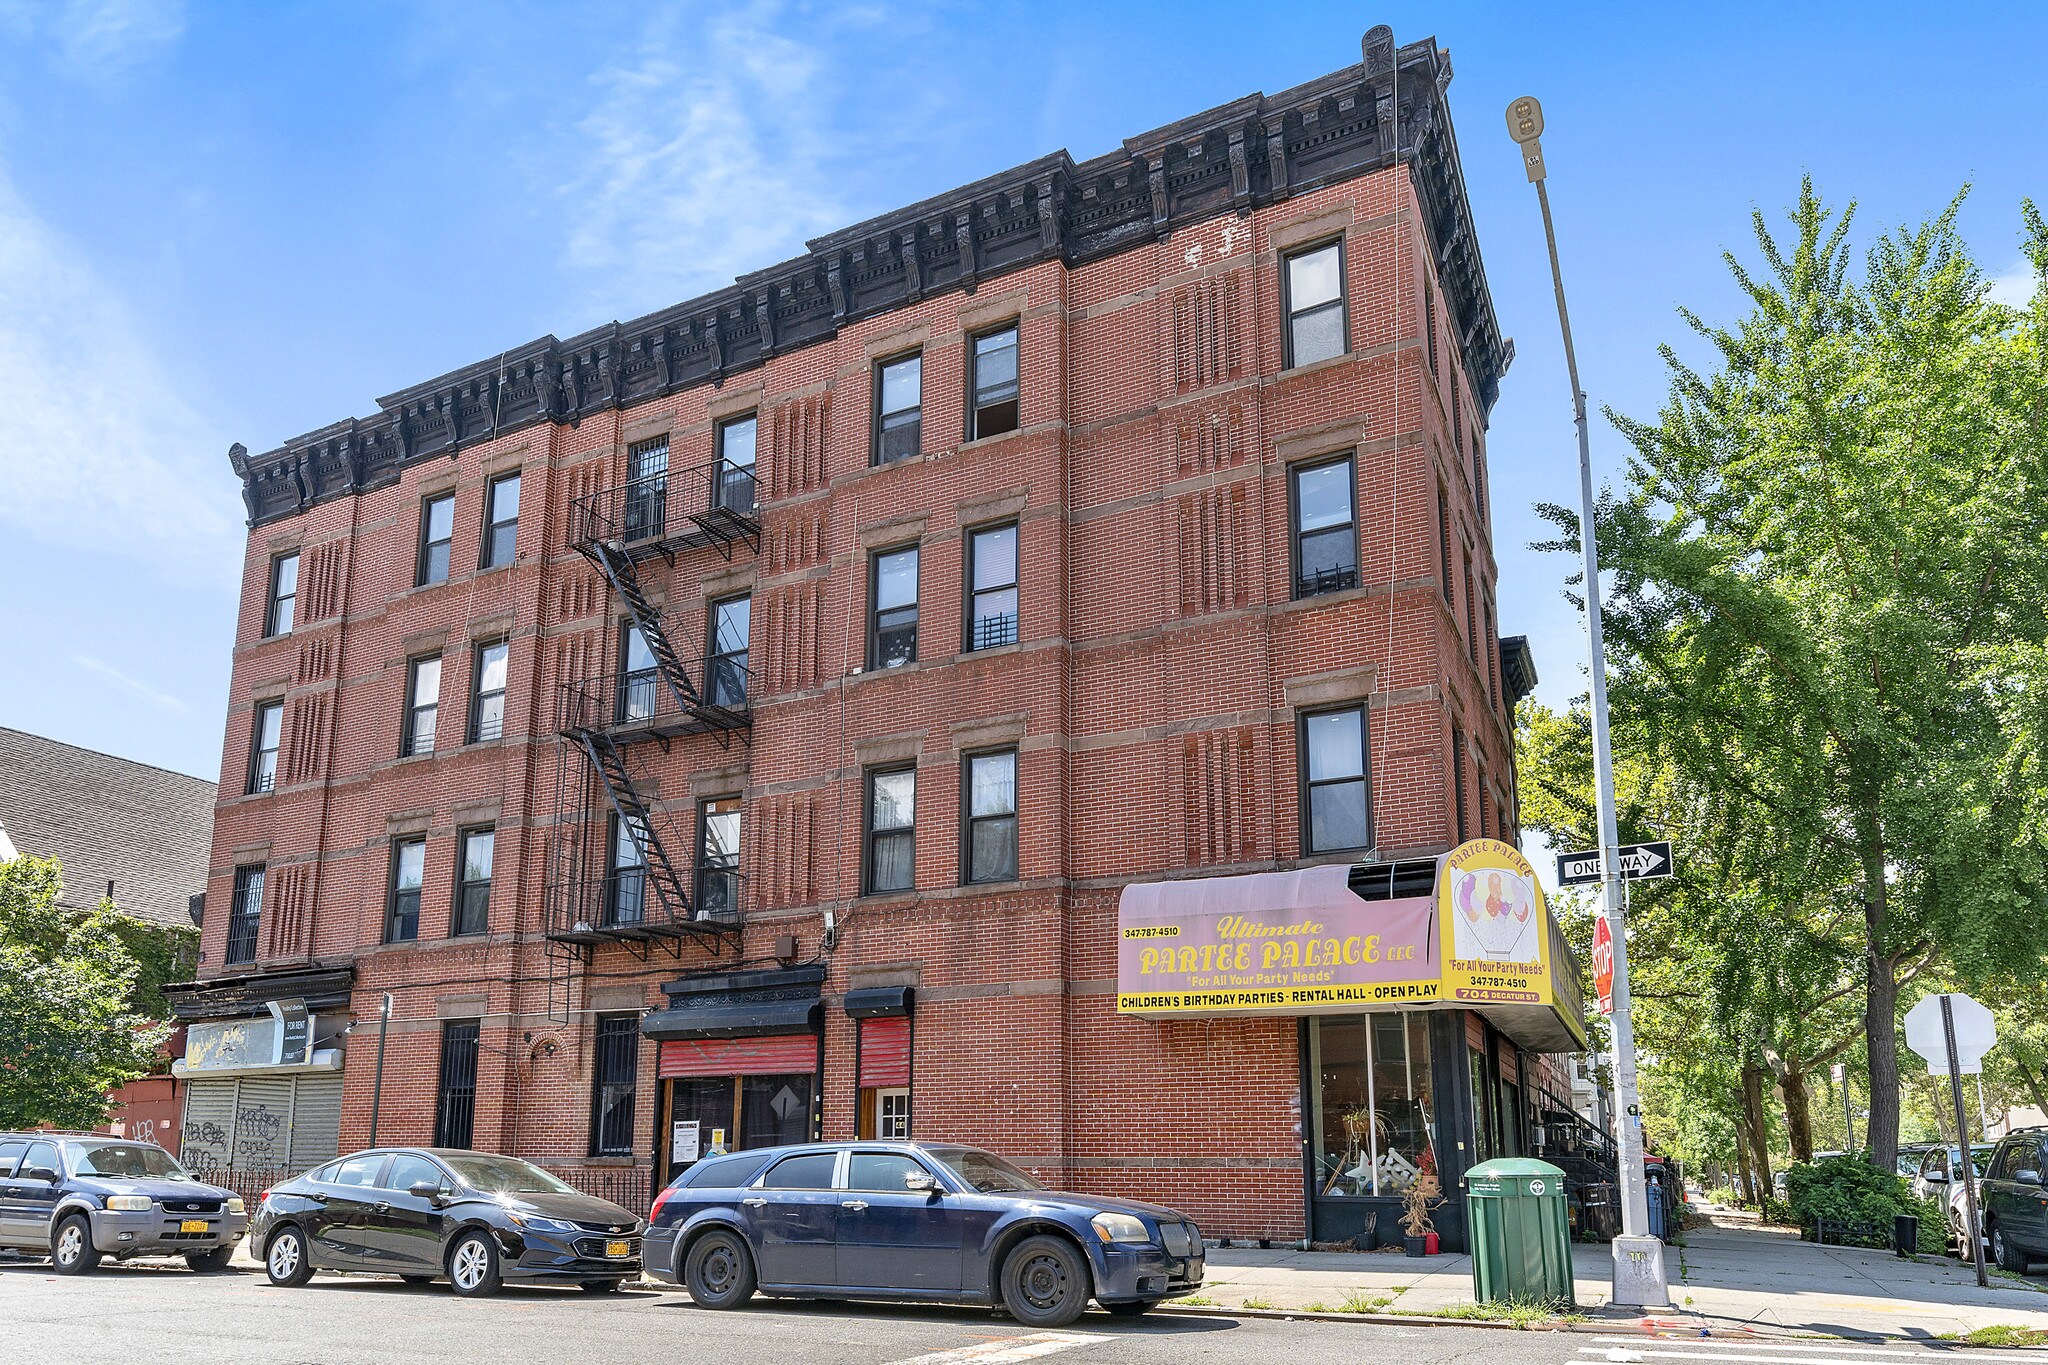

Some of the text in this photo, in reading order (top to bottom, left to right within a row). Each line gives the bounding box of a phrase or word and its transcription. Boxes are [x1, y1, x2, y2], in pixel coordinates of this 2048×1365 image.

[1450, 841, 1533, 878] PARTEE PALACE
[1619, 854, 1652, 870] WAY
[1125, 927, 1178, 938] 347-787-4510
[1217, 916, 1324, 939] Ultimate
[1140, 934, 1415, 974] PARTEE PALACE LLC
[1593, 940, 1611, 979] STOP
[1466, 960, 1477, 971] All
[1477, 961, 1495, 973] Your
[1496, 962, 1518, 976] Party
[1213, 975, 1227, 986] All
[1229, 974, 1254, 985] Your
[1256, 973, 1289, 986] Party
[1470, 976, 1527, 988] 347-787-4510
[1121, 996, 1180, 1008] CHILDREN'S
[1183, 994, 1236, 1006] BIRTHDAY
[1238, 992, 1284, 1004] PARTIES
[1292, 989, 1335, 1002] RENTAL
[1337, 988, 1366, 1000] HALL
[1374, 986, 1406, 998] OPEN
[1408, 984, 1438, 997] PLAY
[1460, 990, 1489, 999] 704
[1491, 992, 1525, 1000] DECATUR
